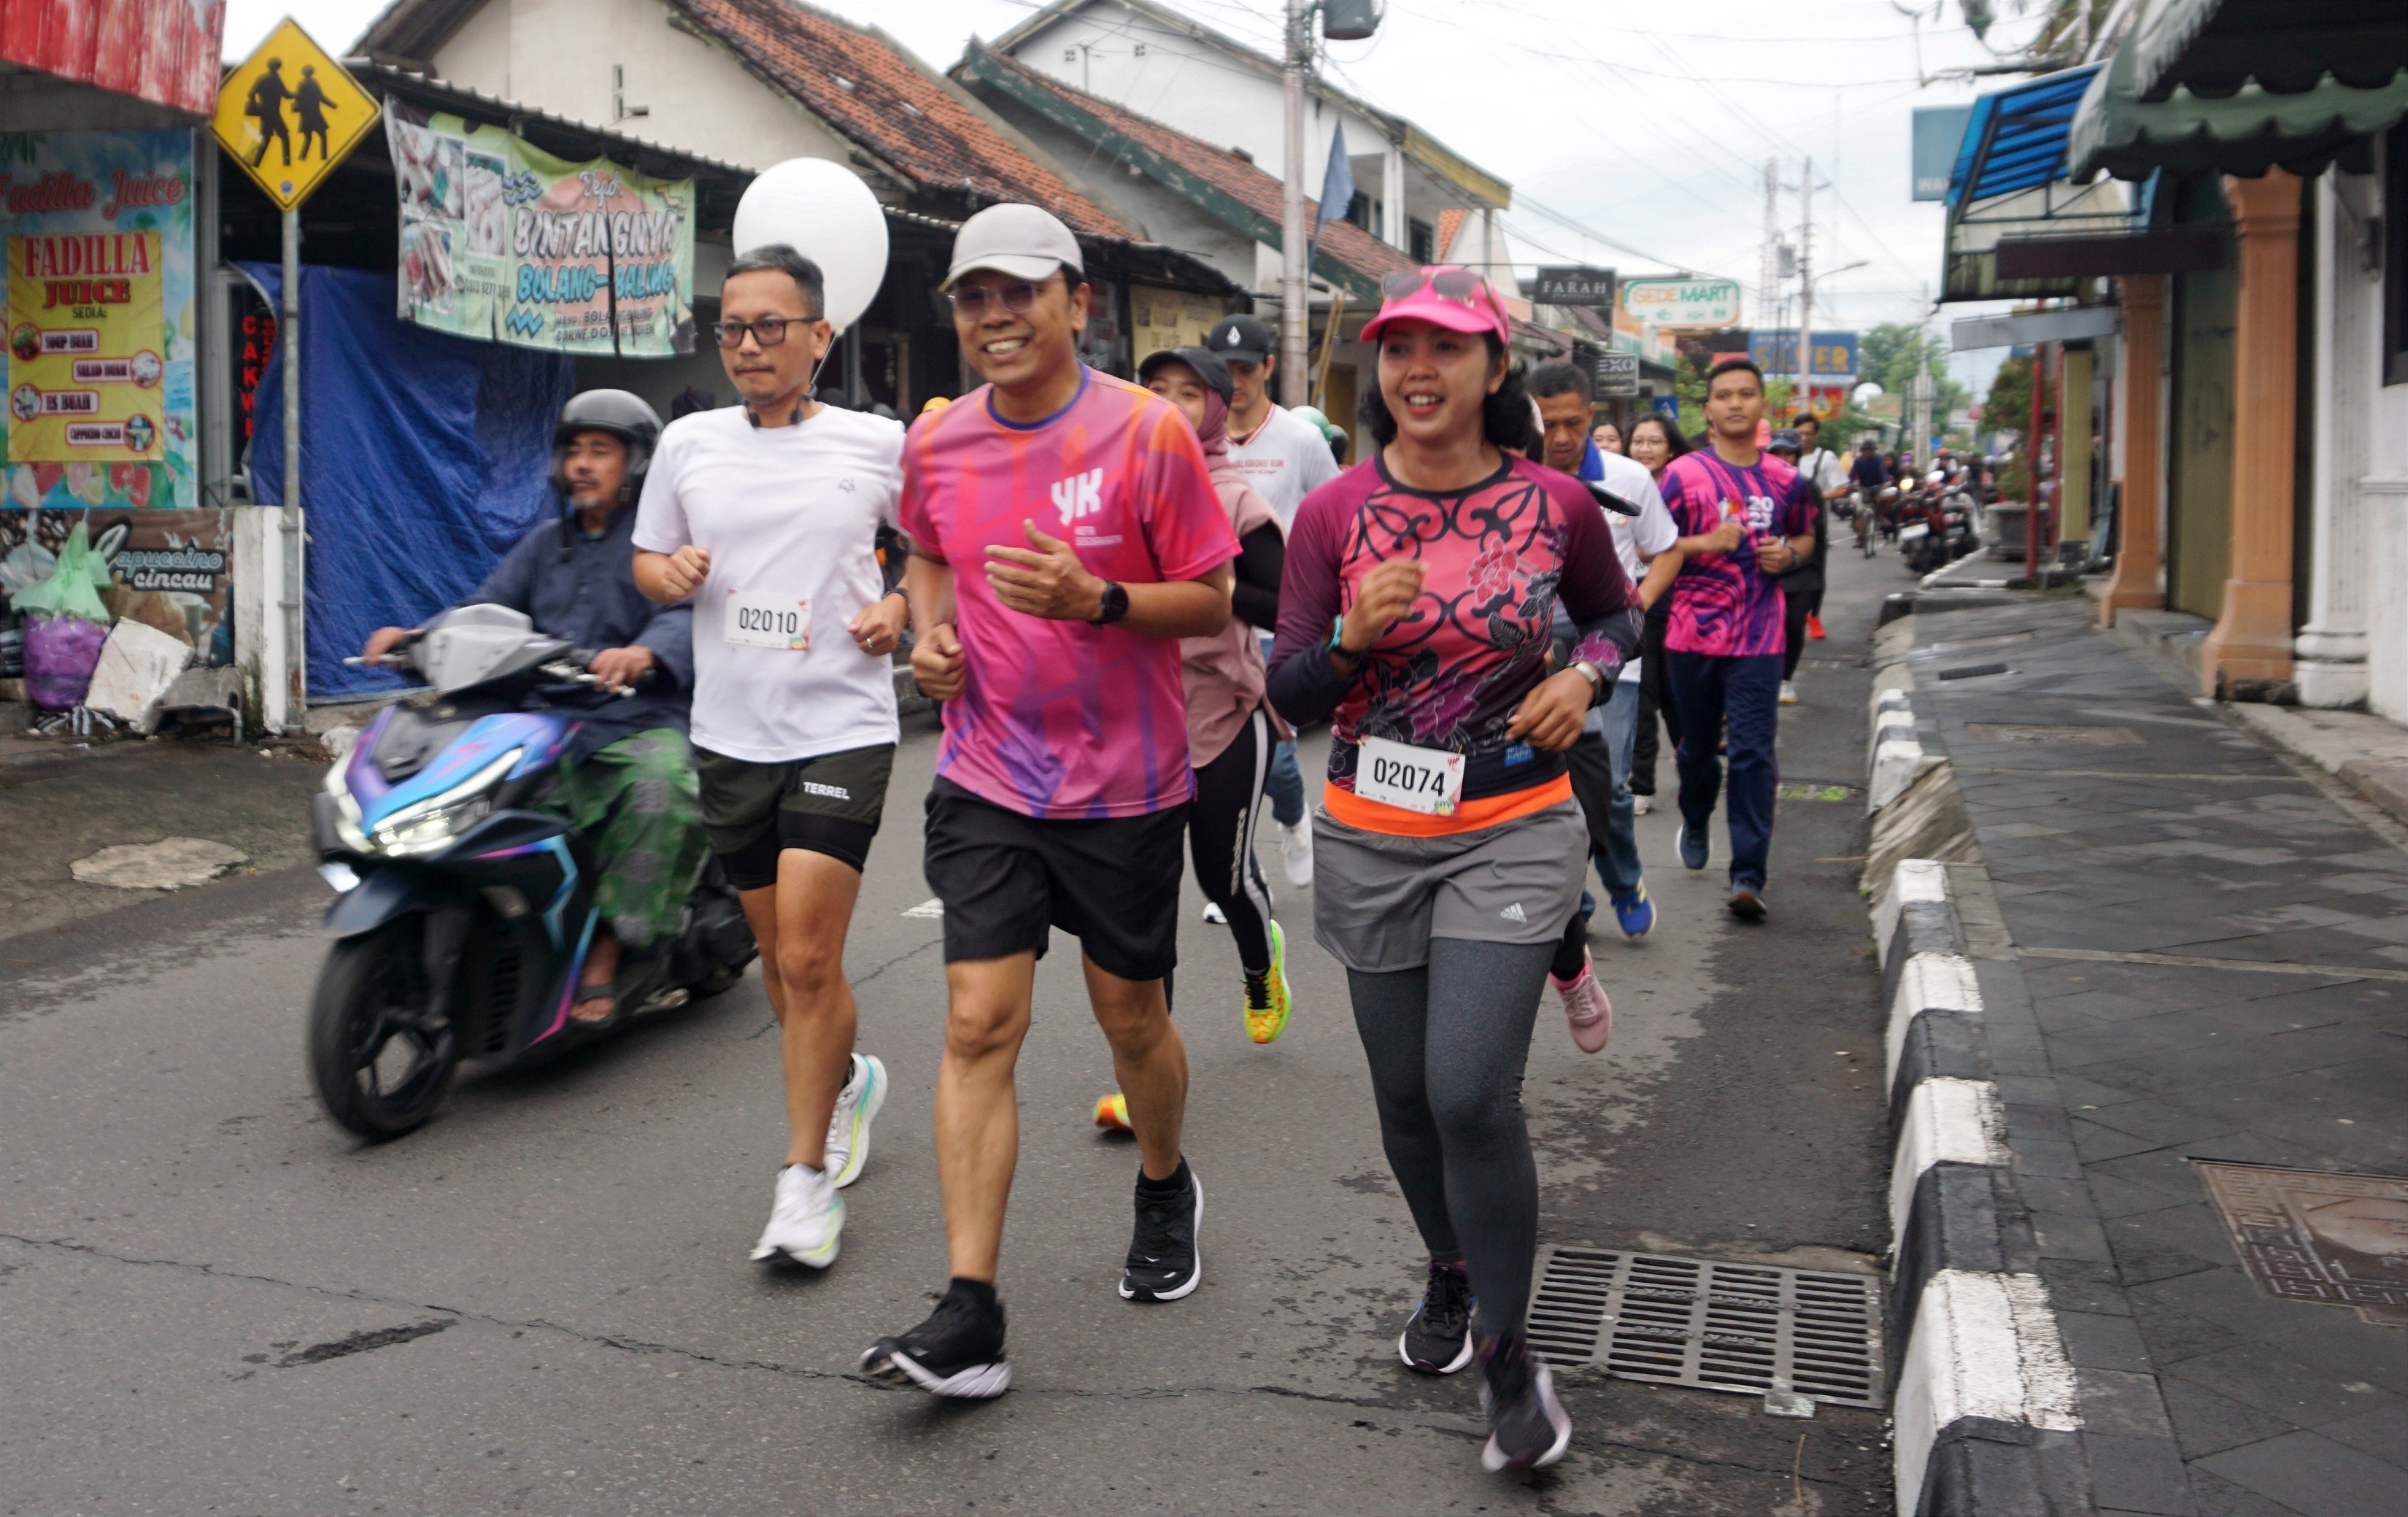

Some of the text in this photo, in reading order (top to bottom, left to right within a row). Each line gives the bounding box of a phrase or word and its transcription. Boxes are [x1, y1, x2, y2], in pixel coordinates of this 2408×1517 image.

[101, 166, 185, 220] Juice
[514, 206, 678, 258] BINTANGNYA
[23, 233, 150, 278] FADILLA
[42, 278, 131, 309] JUICE
[1543, 280, 1607, 294] FARAH
[1597, 358, 1635, 373] EXO
[134, 569, 212, 589] cincau
[739, 607, 798, 634] 02010
[803, 781, 851, 800] TERREL
[1374, 757, 1445, 798] 02074
